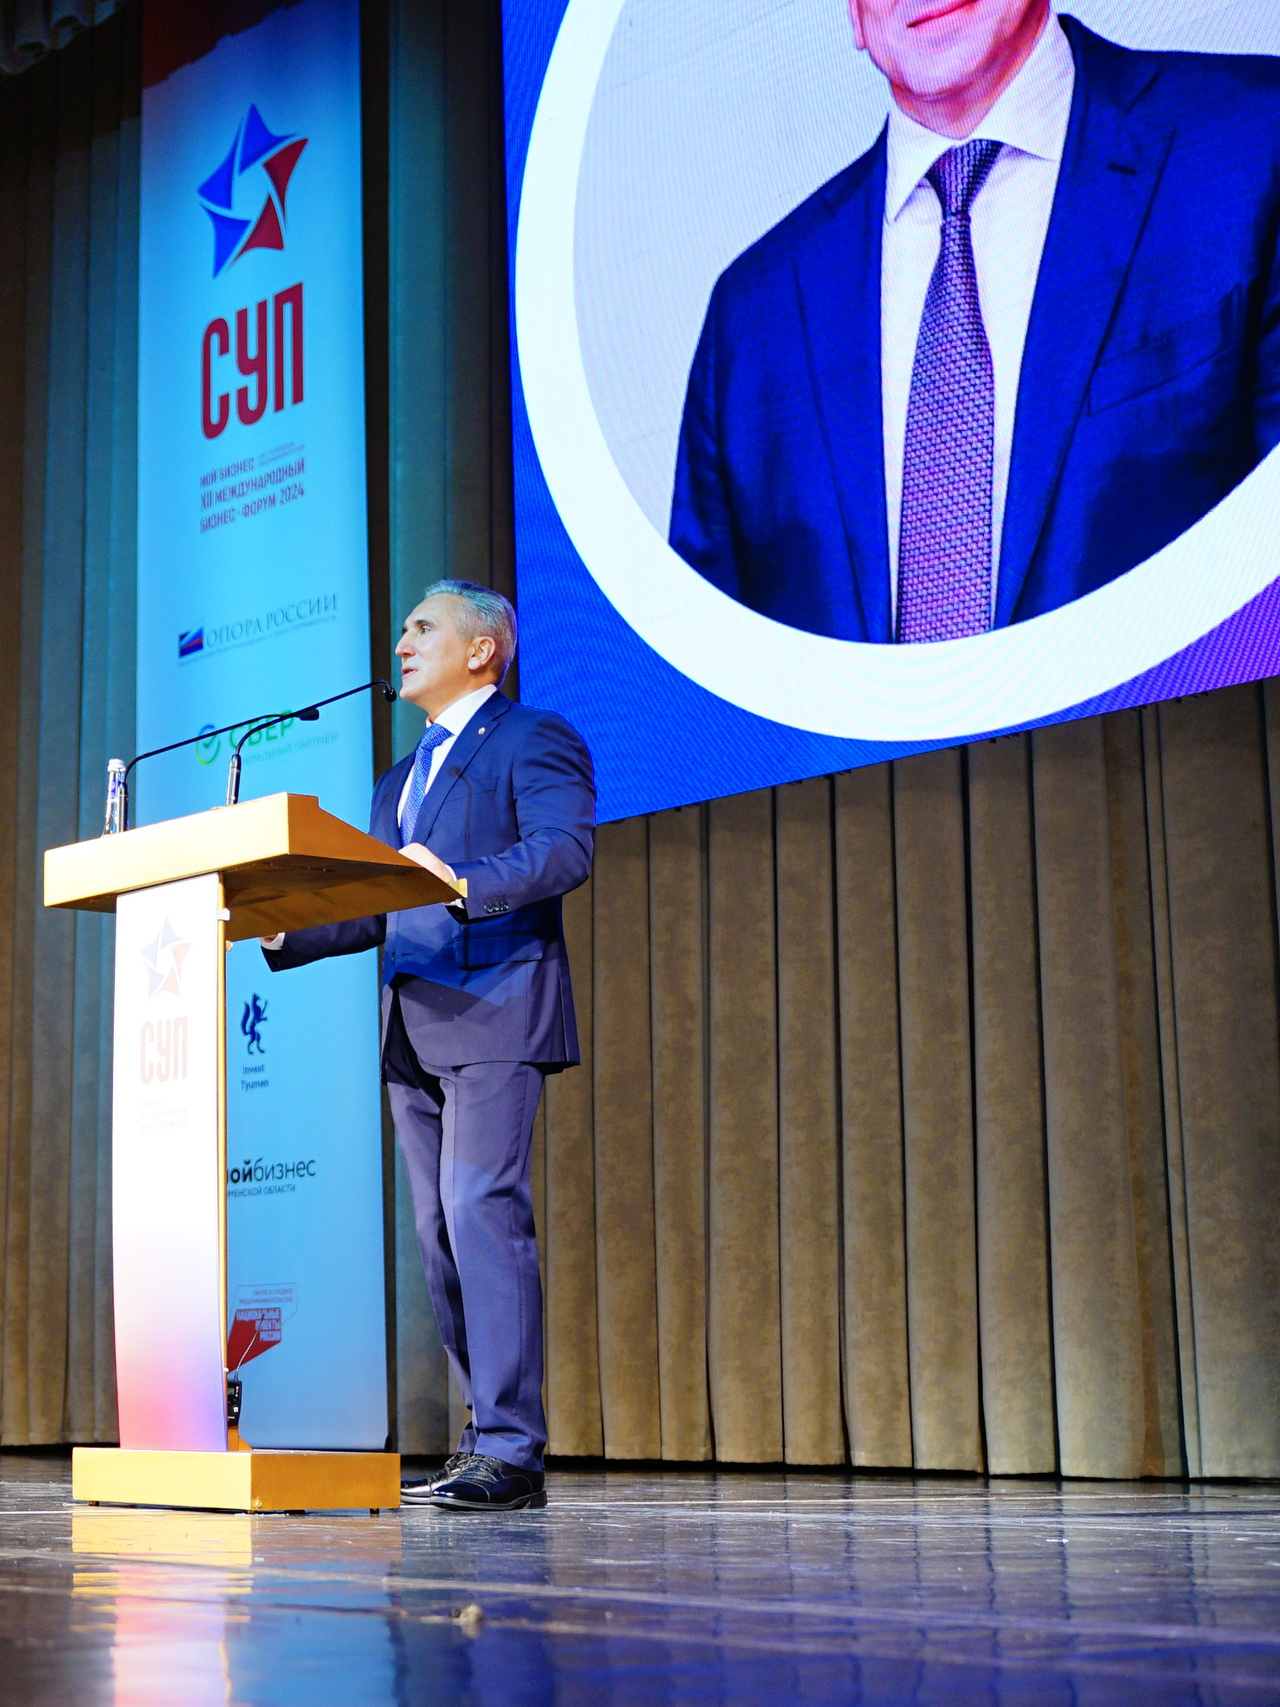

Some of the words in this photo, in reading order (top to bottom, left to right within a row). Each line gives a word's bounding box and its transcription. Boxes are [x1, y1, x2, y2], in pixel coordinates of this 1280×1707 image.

[201, 281, 304, 440] СУП
[215, 455, 305, 505] МЕЖДУНАРОДНЫЙ
[220, 457, 254, 481] БИЗНЕС
[279, 482, 305, 505] 2024
[206, 616, 262, 648] ОПОРА
[267, 594, 337, 630] РОССИИ
[140, 1016, 188, 1085] СУП
[240, 1079, 269, 1092] Tyumen
